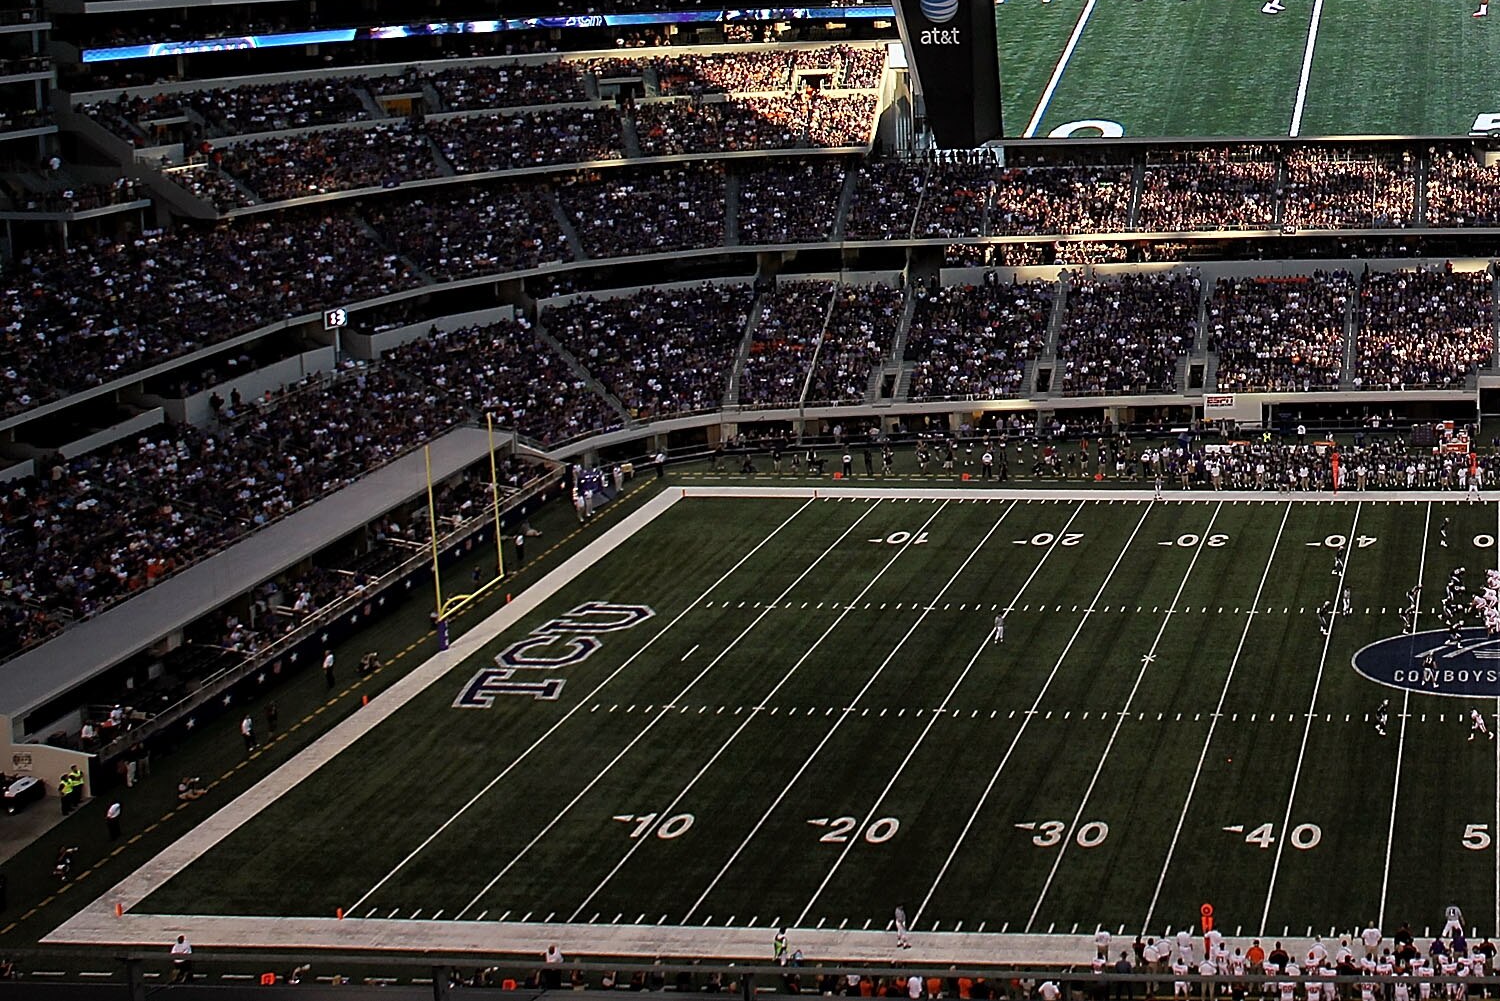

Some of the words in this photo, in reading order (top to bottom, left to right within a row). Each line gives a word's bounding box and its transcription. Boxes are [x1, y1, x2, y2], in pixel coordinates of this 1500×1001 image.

[920, 27, 960, 45] at&t
[451, 601, 656, 709] TCU
[1394, 669, 1498, 683] COWBOYS
